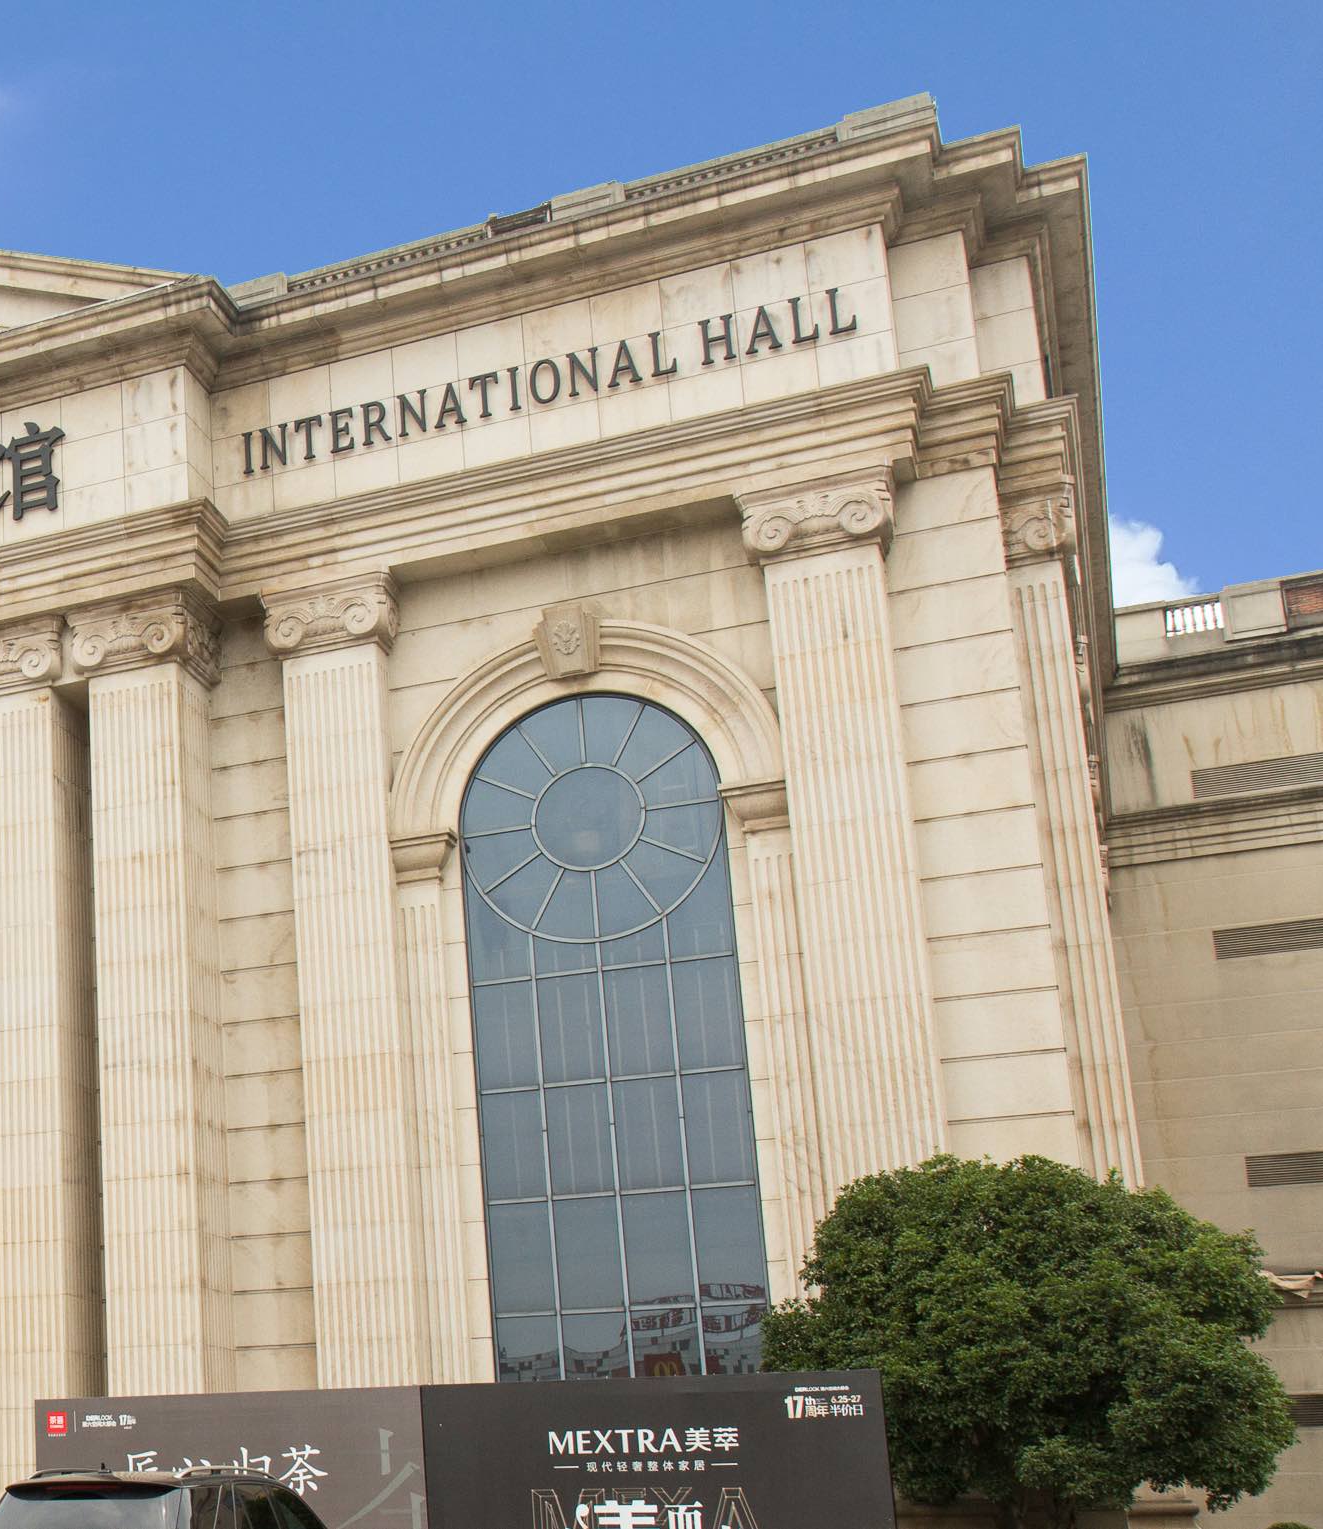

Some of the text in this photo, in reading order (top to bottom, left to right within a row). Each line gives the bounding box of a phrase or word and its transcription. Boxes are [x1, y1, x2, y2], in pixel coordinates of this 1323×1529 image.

[242, 287, 857, 475] INTERNATIONAL HALL
[830, 1394, 861, 1403] 6.25-27
[585, 1459, 706, 1473] 现代轻奢整体家居
